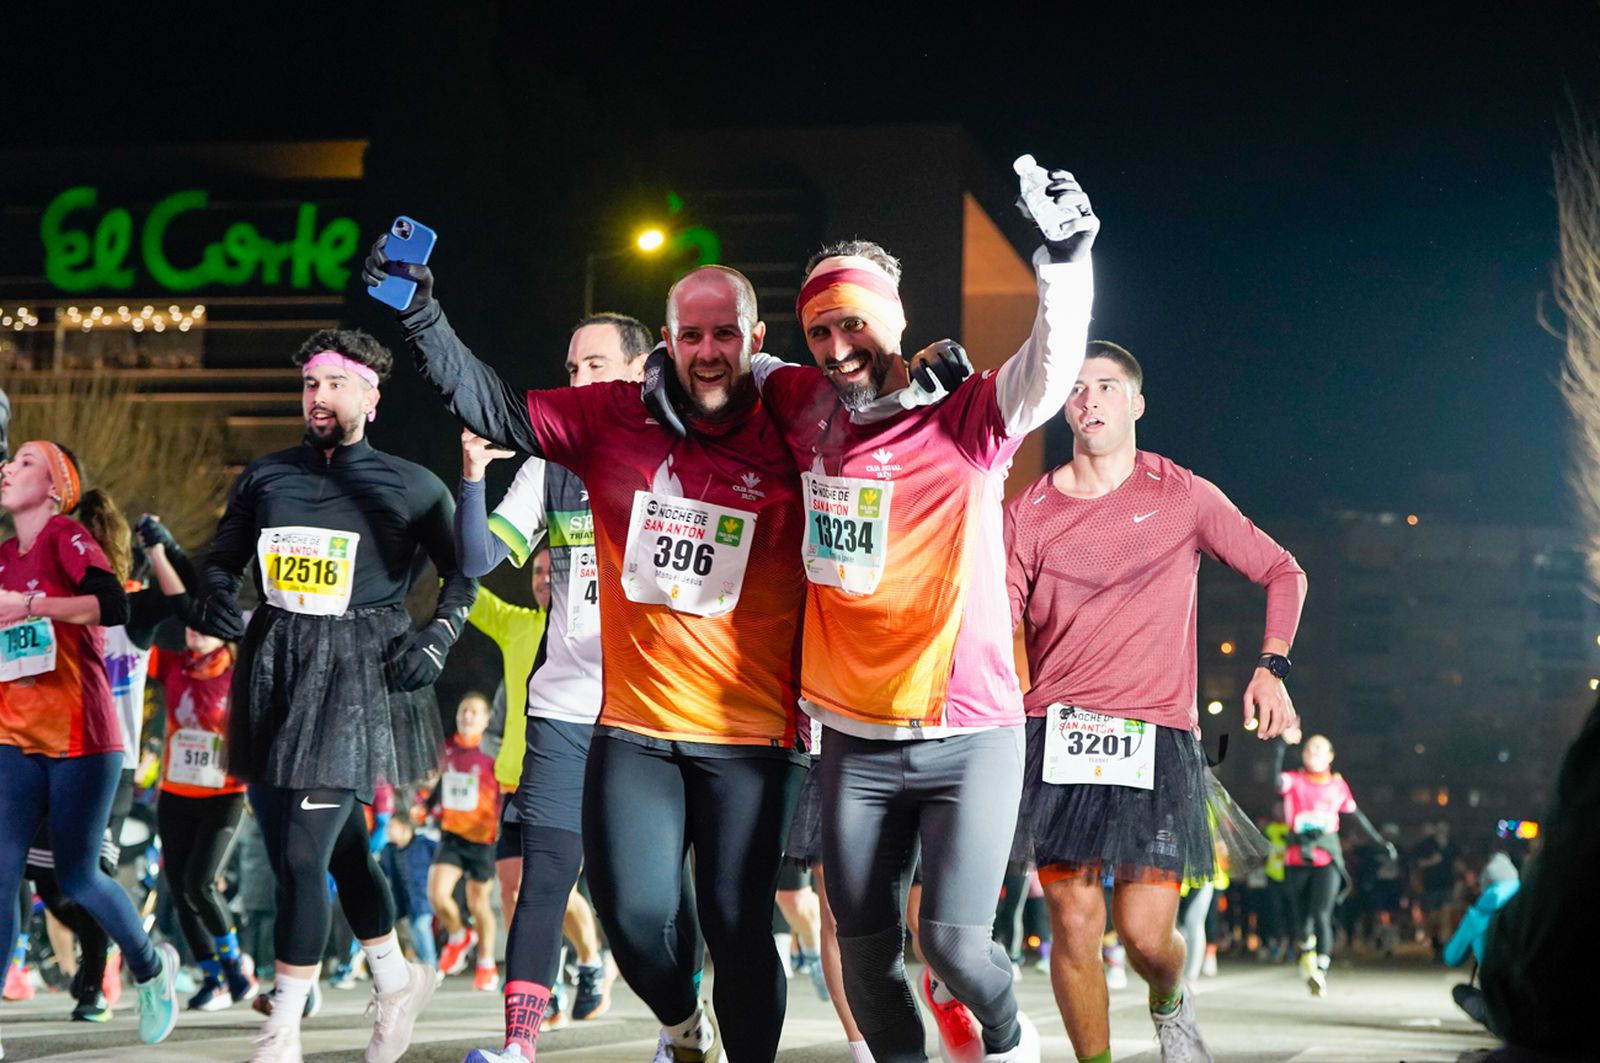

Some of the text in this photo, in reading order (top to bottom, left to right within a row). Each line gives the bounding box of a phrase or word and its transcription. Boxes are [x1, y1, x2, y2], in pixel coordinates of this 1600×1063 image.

[41, 187, 359, 291] El Corte
[819, 488, 850, 502] NOCHE DE
[813, 499, 825, 512] SAN
[644, 518, 665, 532] SAN
[658, 508, 693, 523] NOCHE
[694, 514, 708, 526] DE
[815, 514, 873, 554] 13234
[653, 536, 715, 576] 396
[273, 556, 338, 586] 12518
[580, 568, 596, 578] SAN
[584, 580, 598, 605] 4
[1058, 721, 1079, 731] SAN
[1071, 712, 1102, 722] NOCHE
[1067, 731, 1132, 758] 3201
